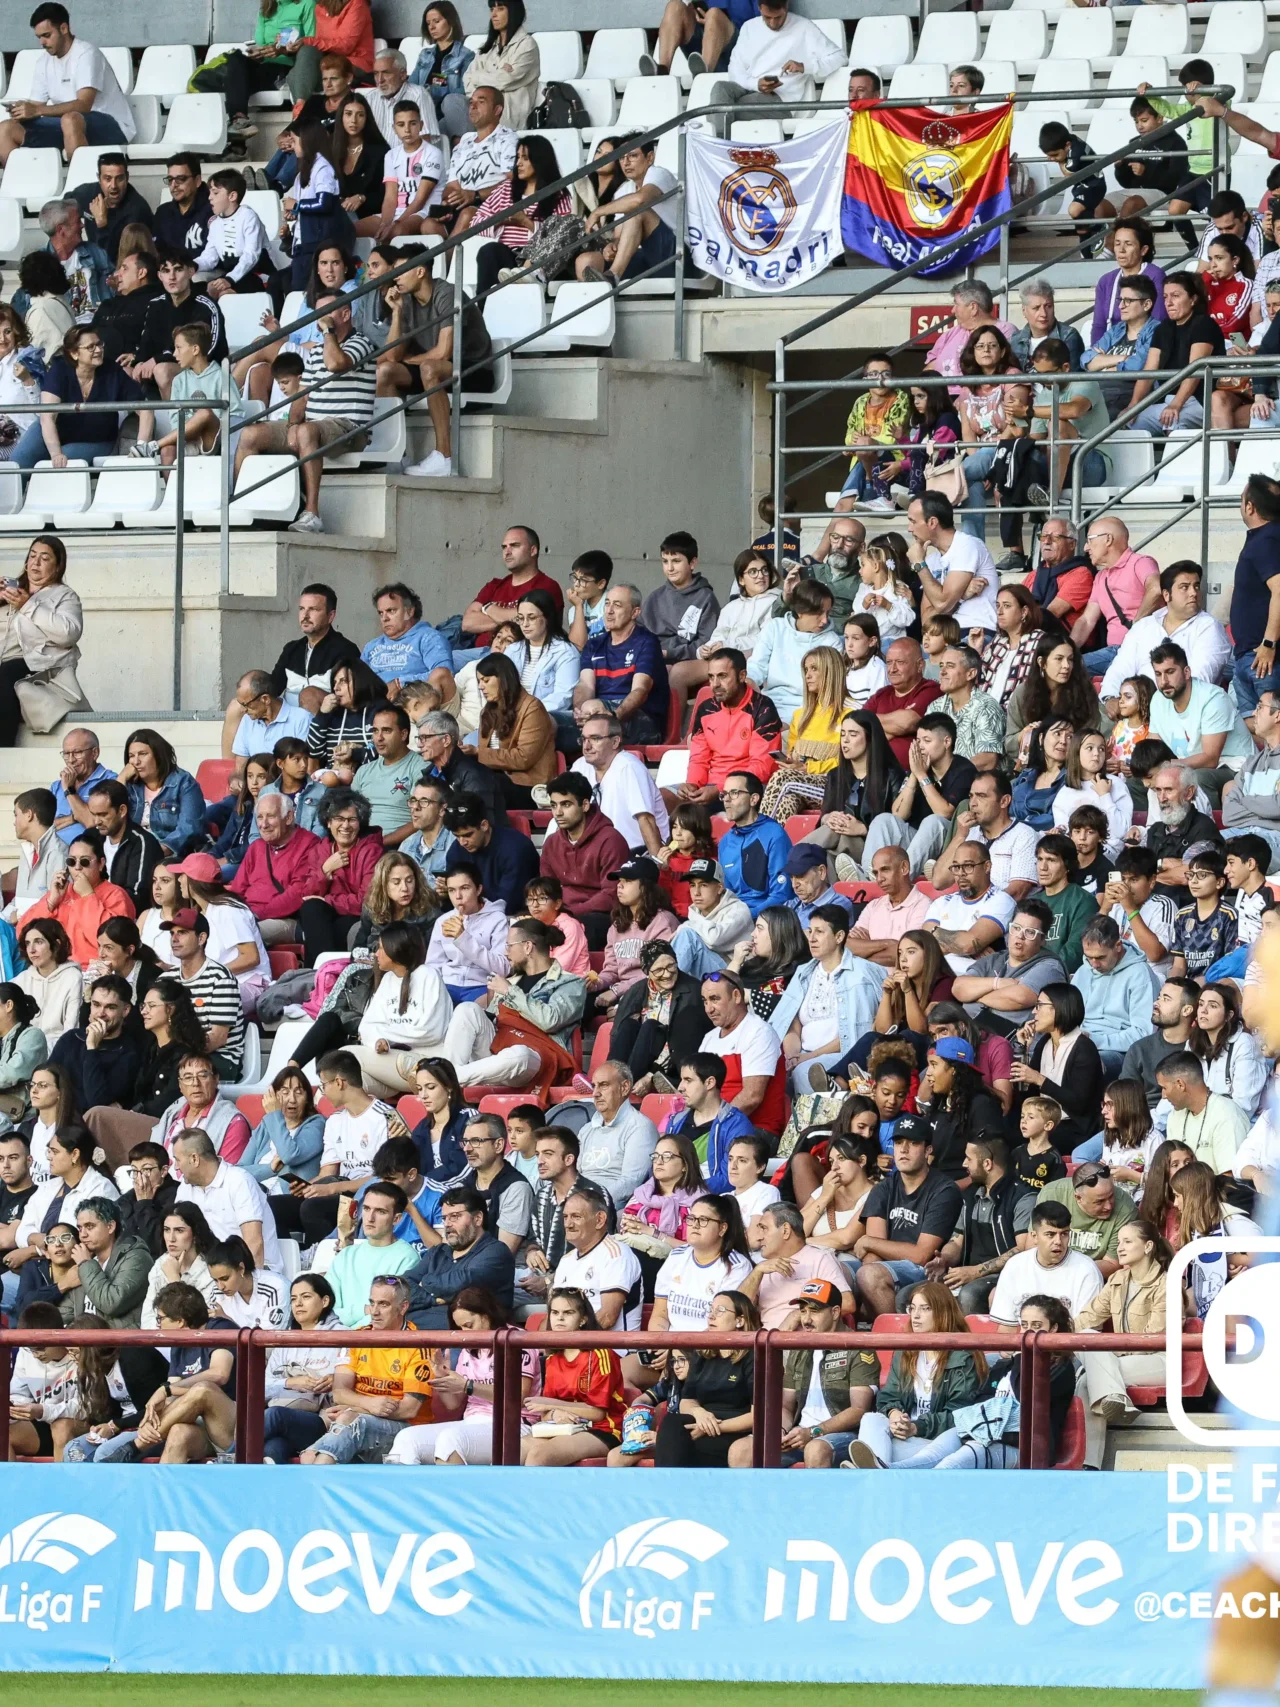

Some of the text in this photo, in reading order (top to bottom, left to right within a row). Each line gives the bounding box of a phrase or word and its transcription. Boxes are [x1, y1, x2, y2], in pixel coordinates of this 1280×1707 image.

[1184, 949, 1215, 961] Emirates
[668, 1290, 713, 1313] Emirates
[671, 1305, 706, 1320] FLY BETTER
[416, 1366, 431, 1384] hp
[134, 1528, 477, 1617] moeve
[764, 1538, 1124, 1627] moeve
[0, 1582, 103, 1632] Liga F
[601, 1586, 715, 1640] Liga F
